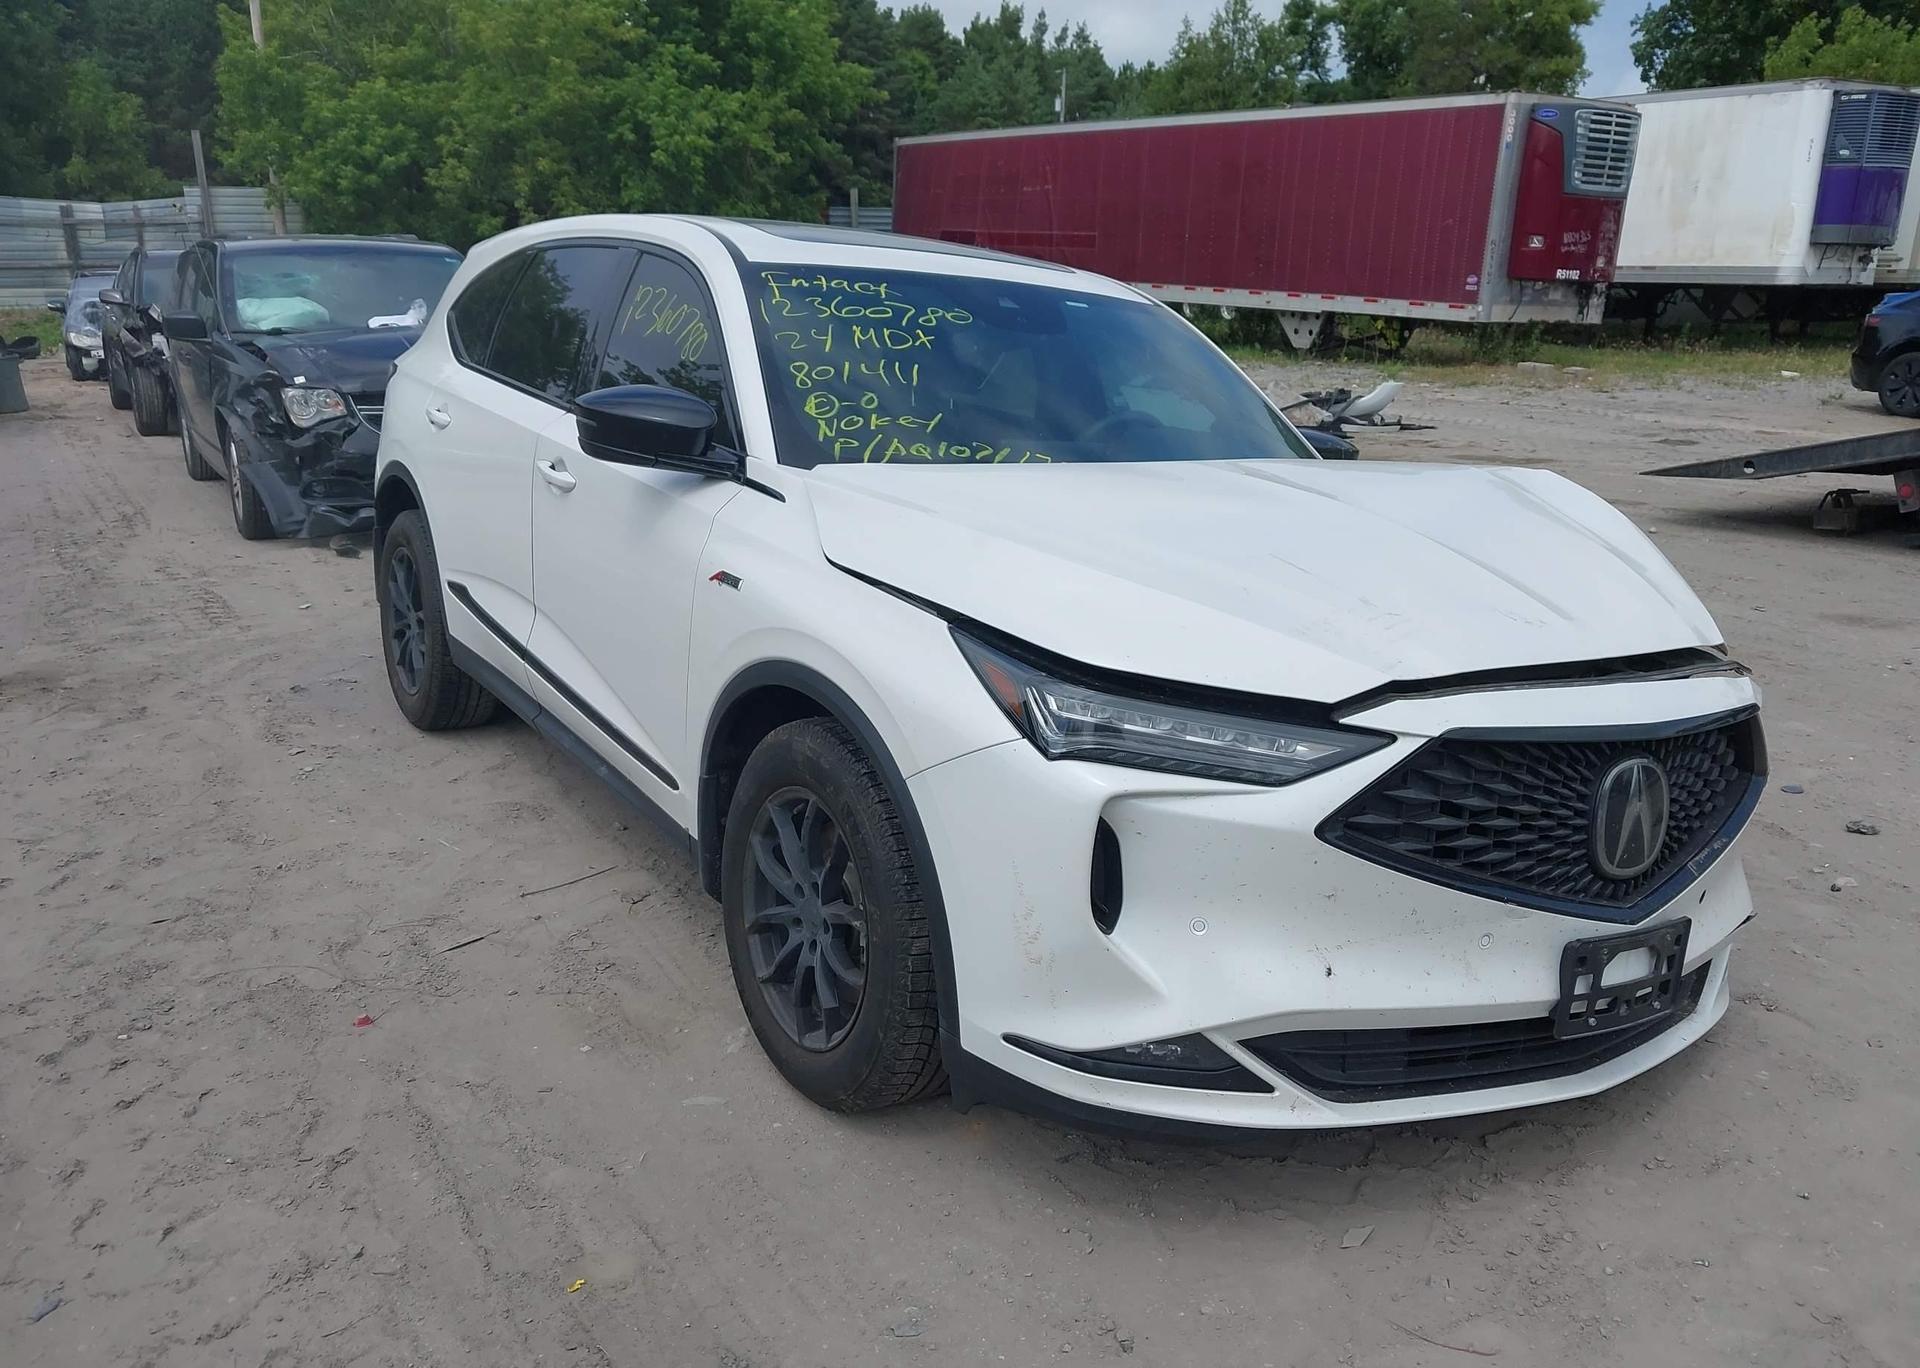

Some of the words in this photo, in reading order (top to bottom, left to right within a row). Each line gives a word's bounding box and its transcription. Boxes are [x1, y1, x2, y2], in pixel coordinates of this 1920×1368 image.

[760, 296, 973, 326] 12360780
[775, 325, 833, 352] 24
[853, 325, 935, 350] MDX
[790, 359, 918, 388] 801411
